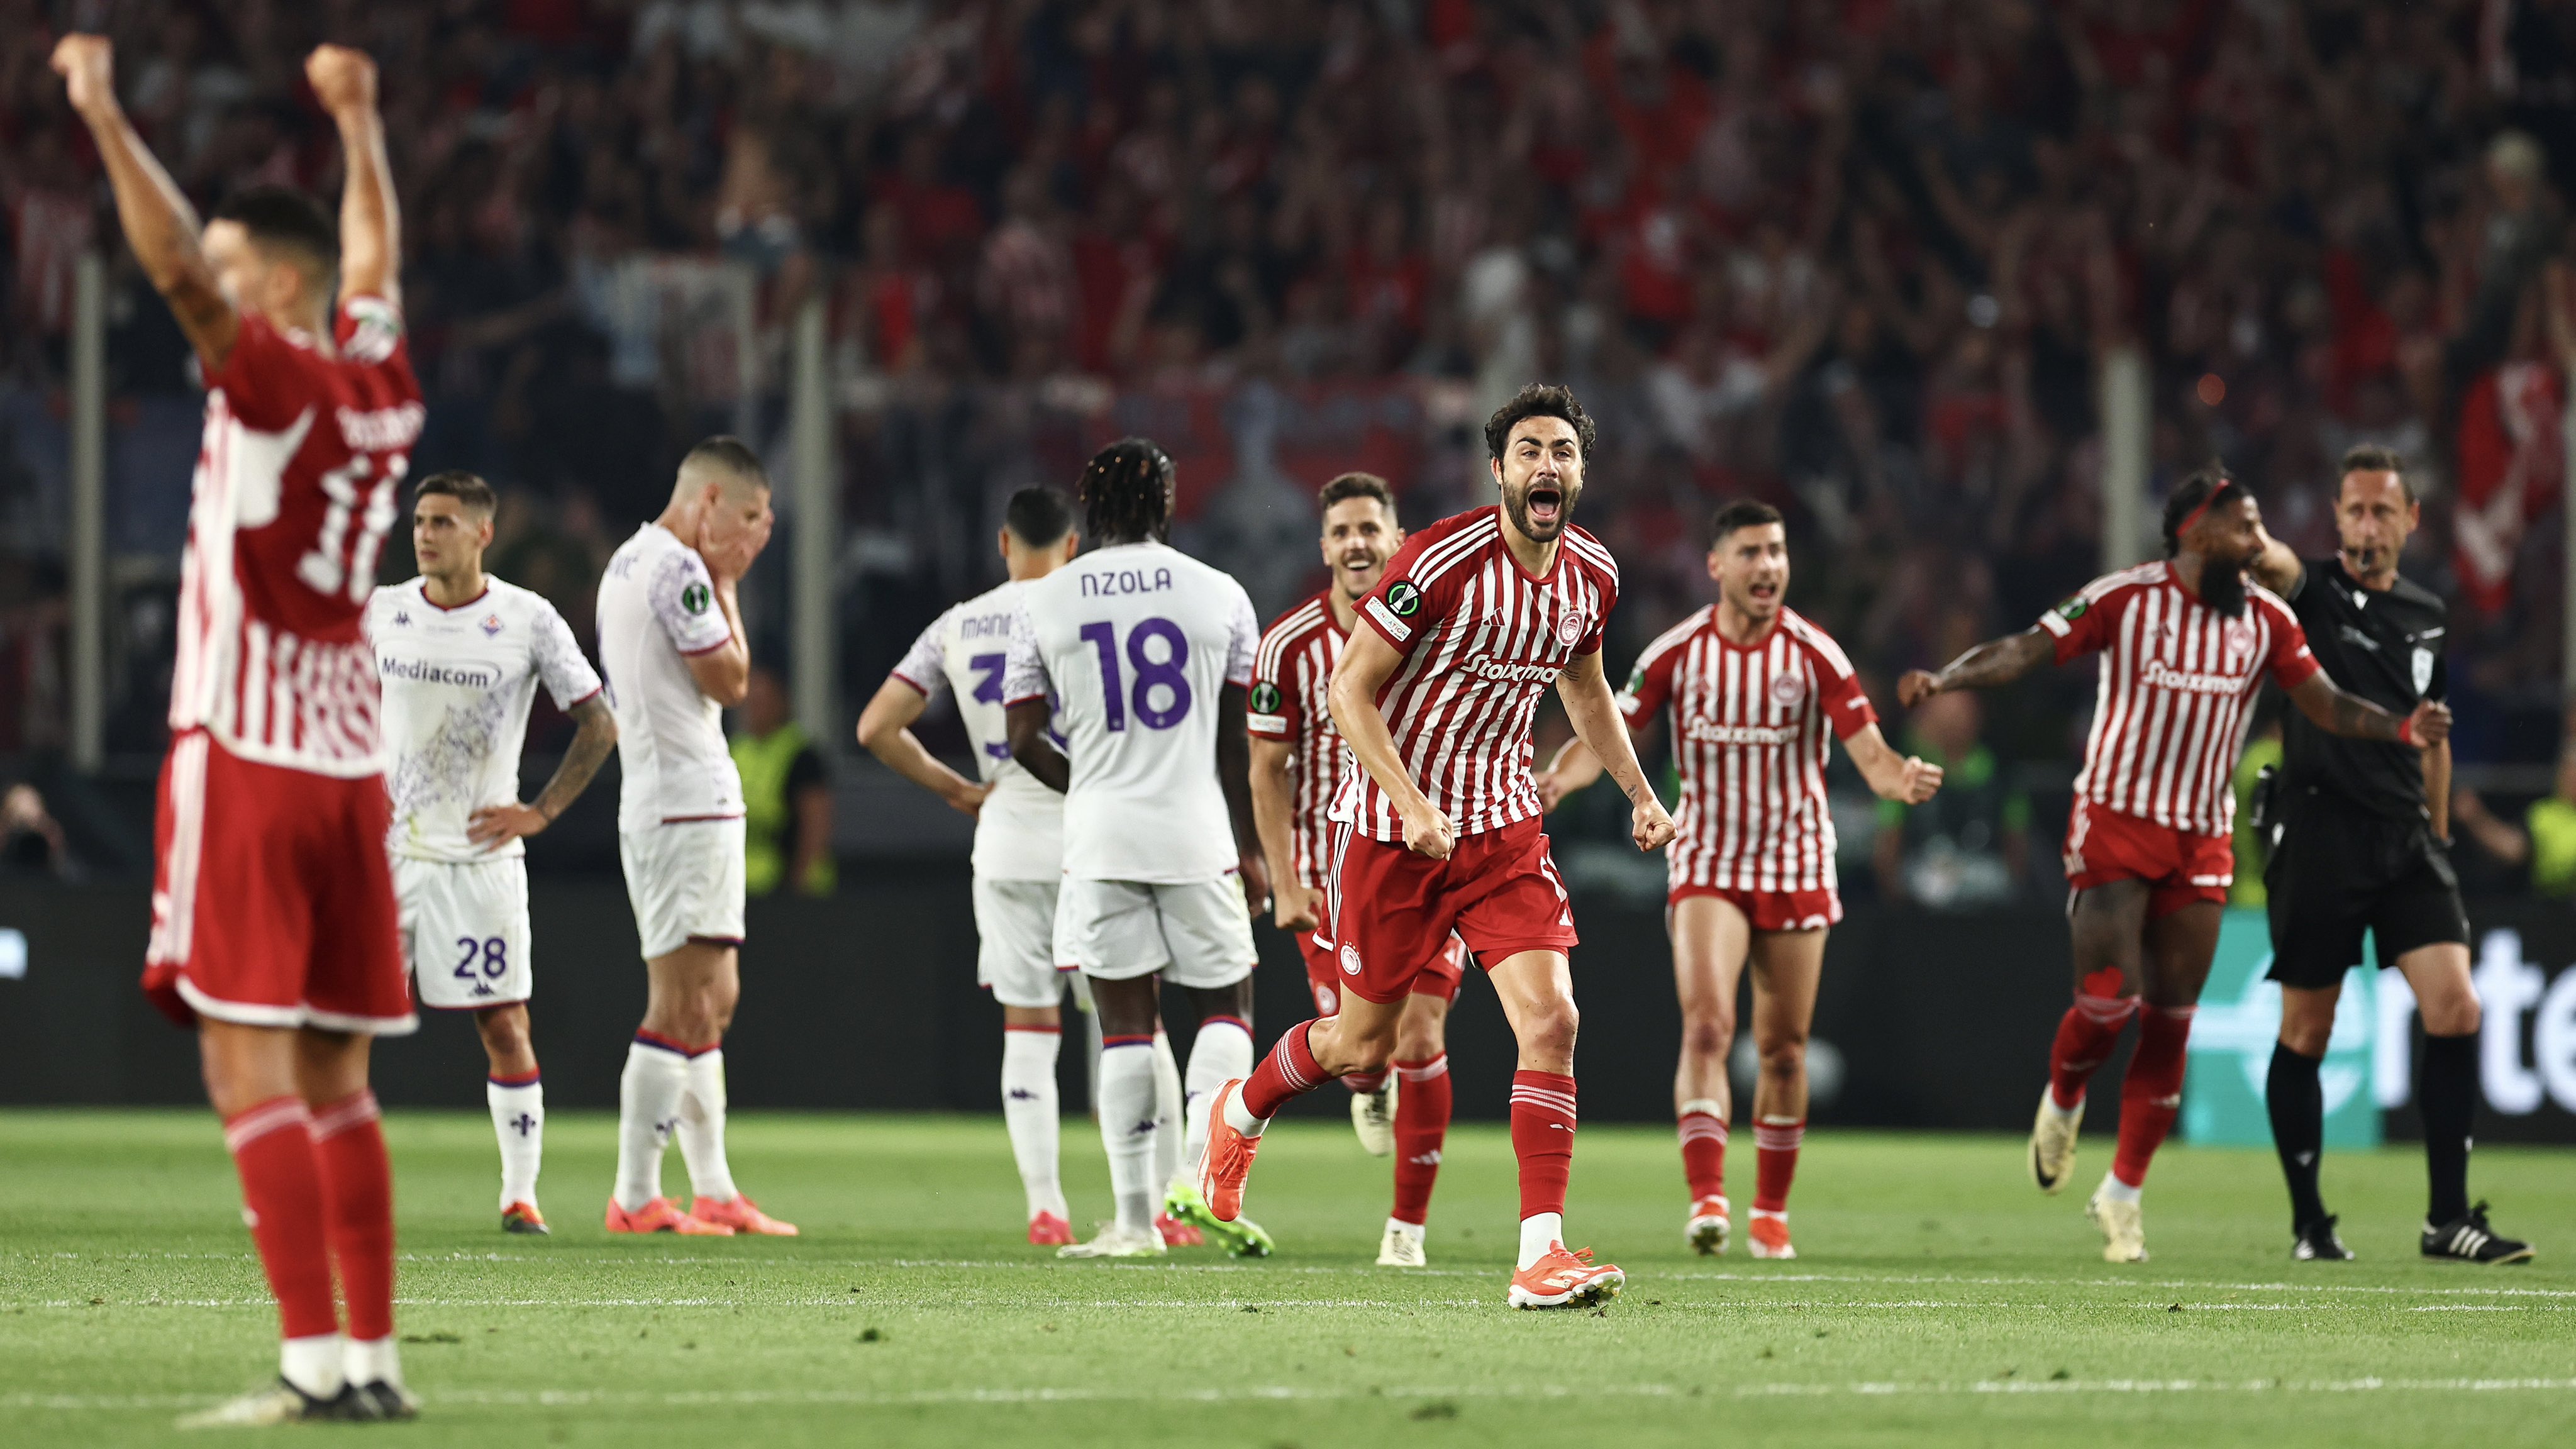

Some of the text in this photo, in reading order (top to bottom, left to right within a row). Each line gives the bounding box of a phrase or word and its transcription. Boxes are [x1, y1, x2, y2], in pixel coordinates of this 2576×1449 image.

[1080, 568, 1172, 597] NZOLA
[1369, 601, 1407, 637] FOUNDATION
[382, 657, 489, 689] Mediacom
[1080, 617, 1192, 733] 18
[454, 937, 508, 979] 28
